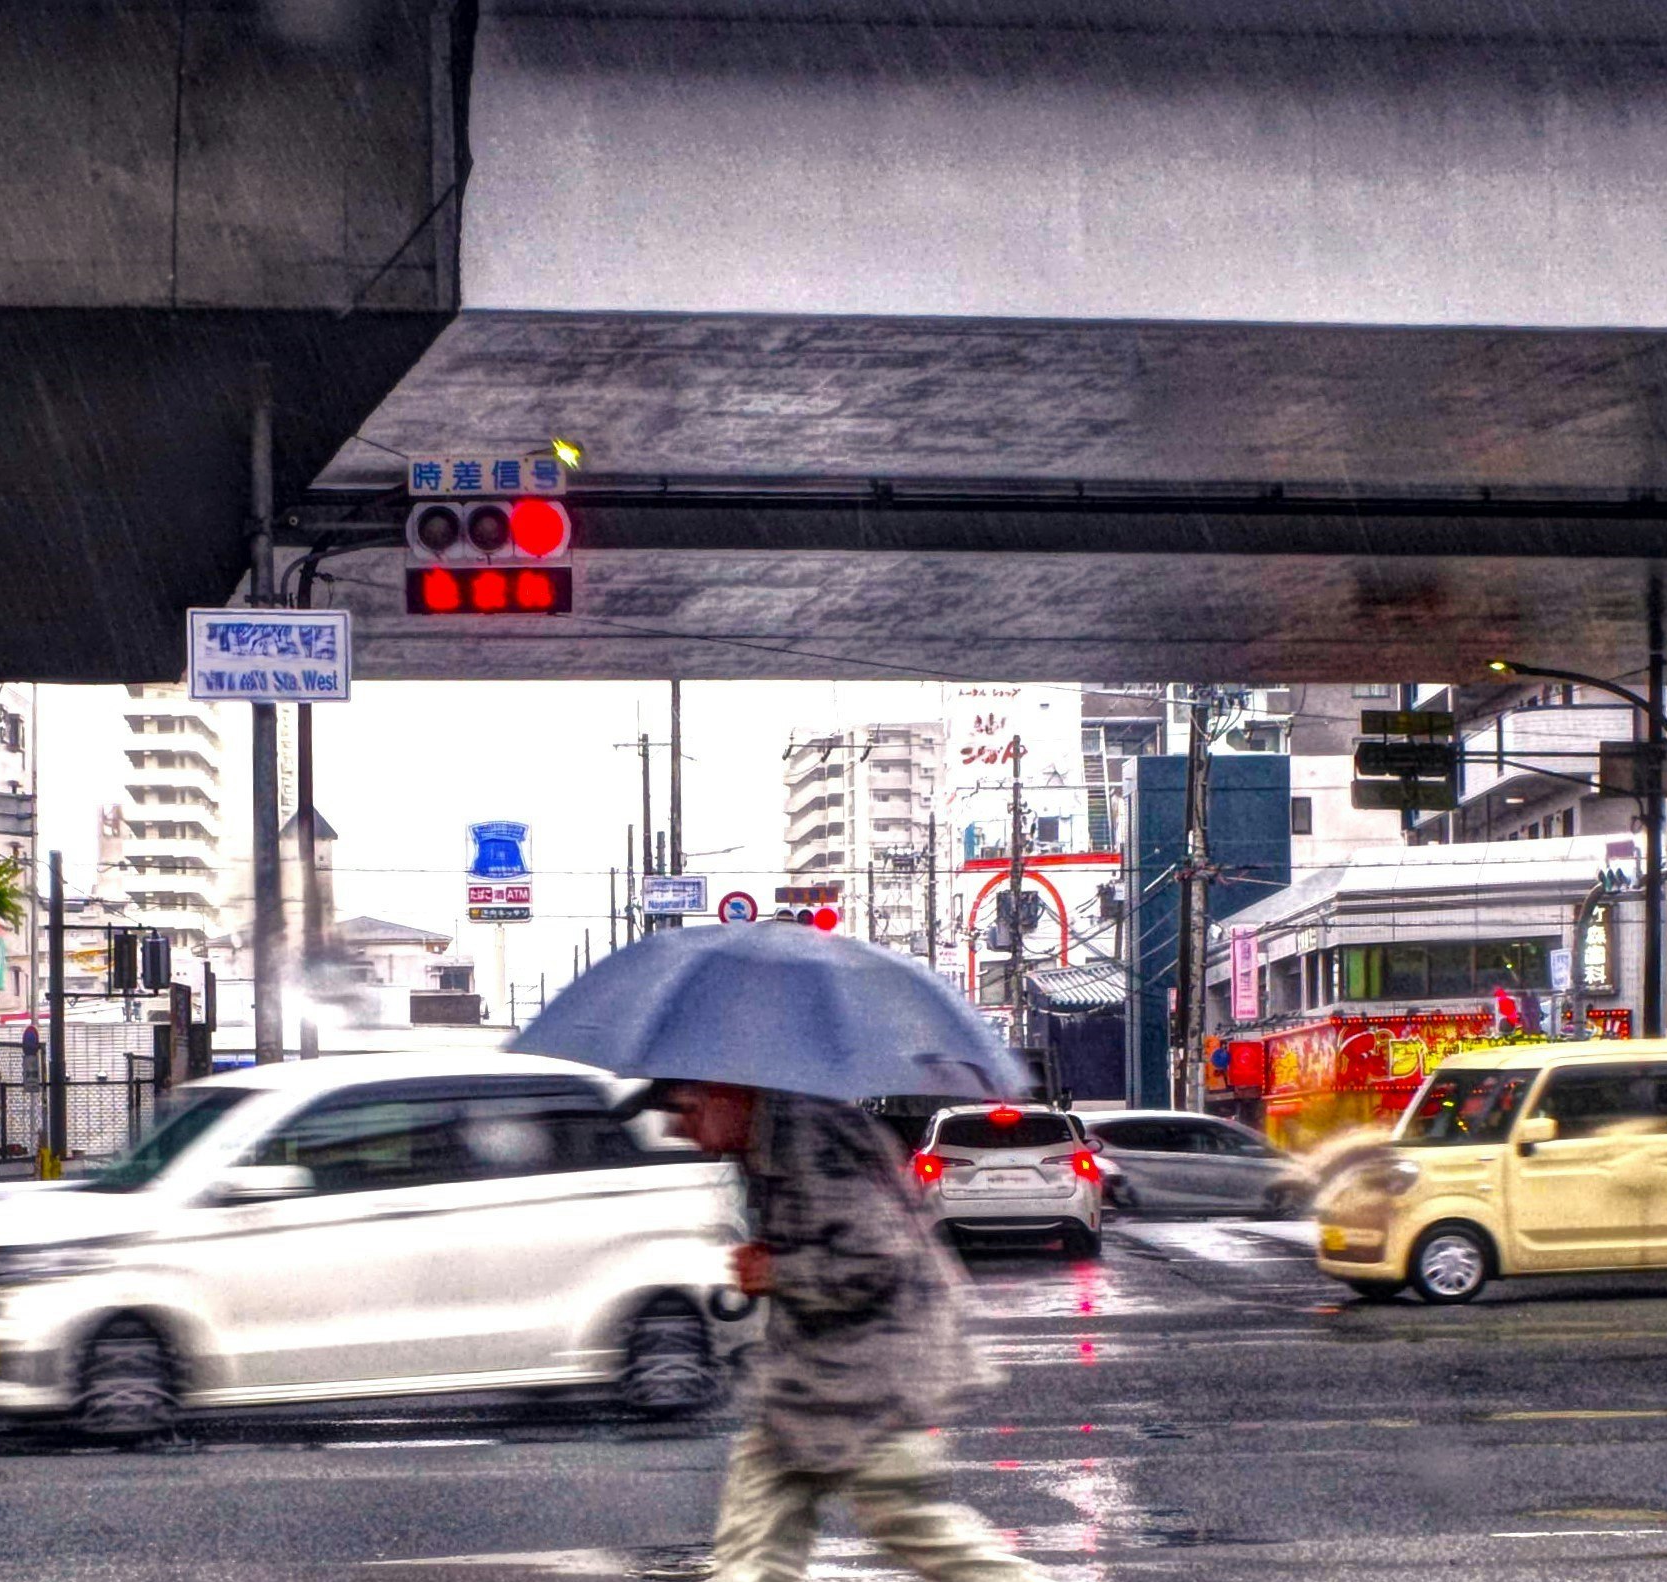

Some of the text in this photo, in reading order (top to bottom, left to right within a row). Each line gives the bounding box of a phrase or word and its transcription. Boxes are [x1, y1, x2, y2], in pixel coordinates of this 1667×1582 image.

[412, 460, 561, 491] 時差信号
[301, 670, 338, 691] West
[507, 889, 529, 900] ATM
